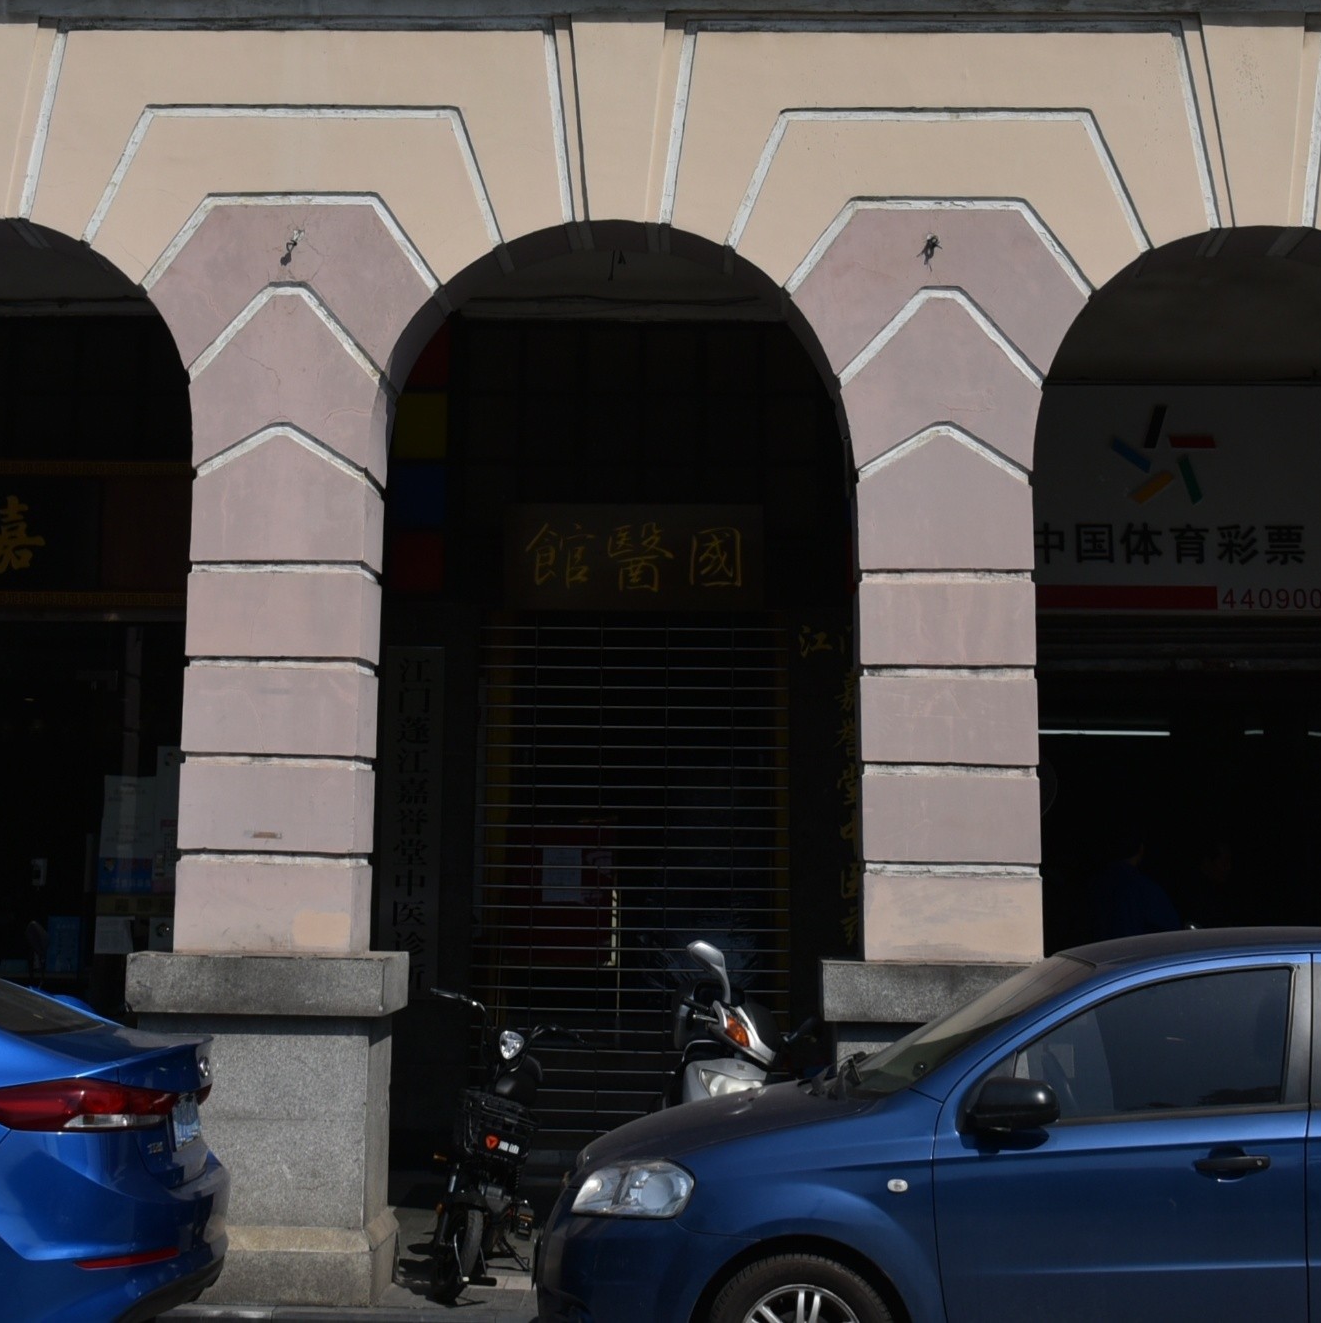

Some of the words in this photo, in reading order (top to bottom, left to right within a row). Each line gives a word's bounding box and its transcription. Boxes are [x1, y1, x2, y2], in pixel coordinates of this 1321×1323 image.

[1034, 521, 1306, 565] 中国体育彩票
